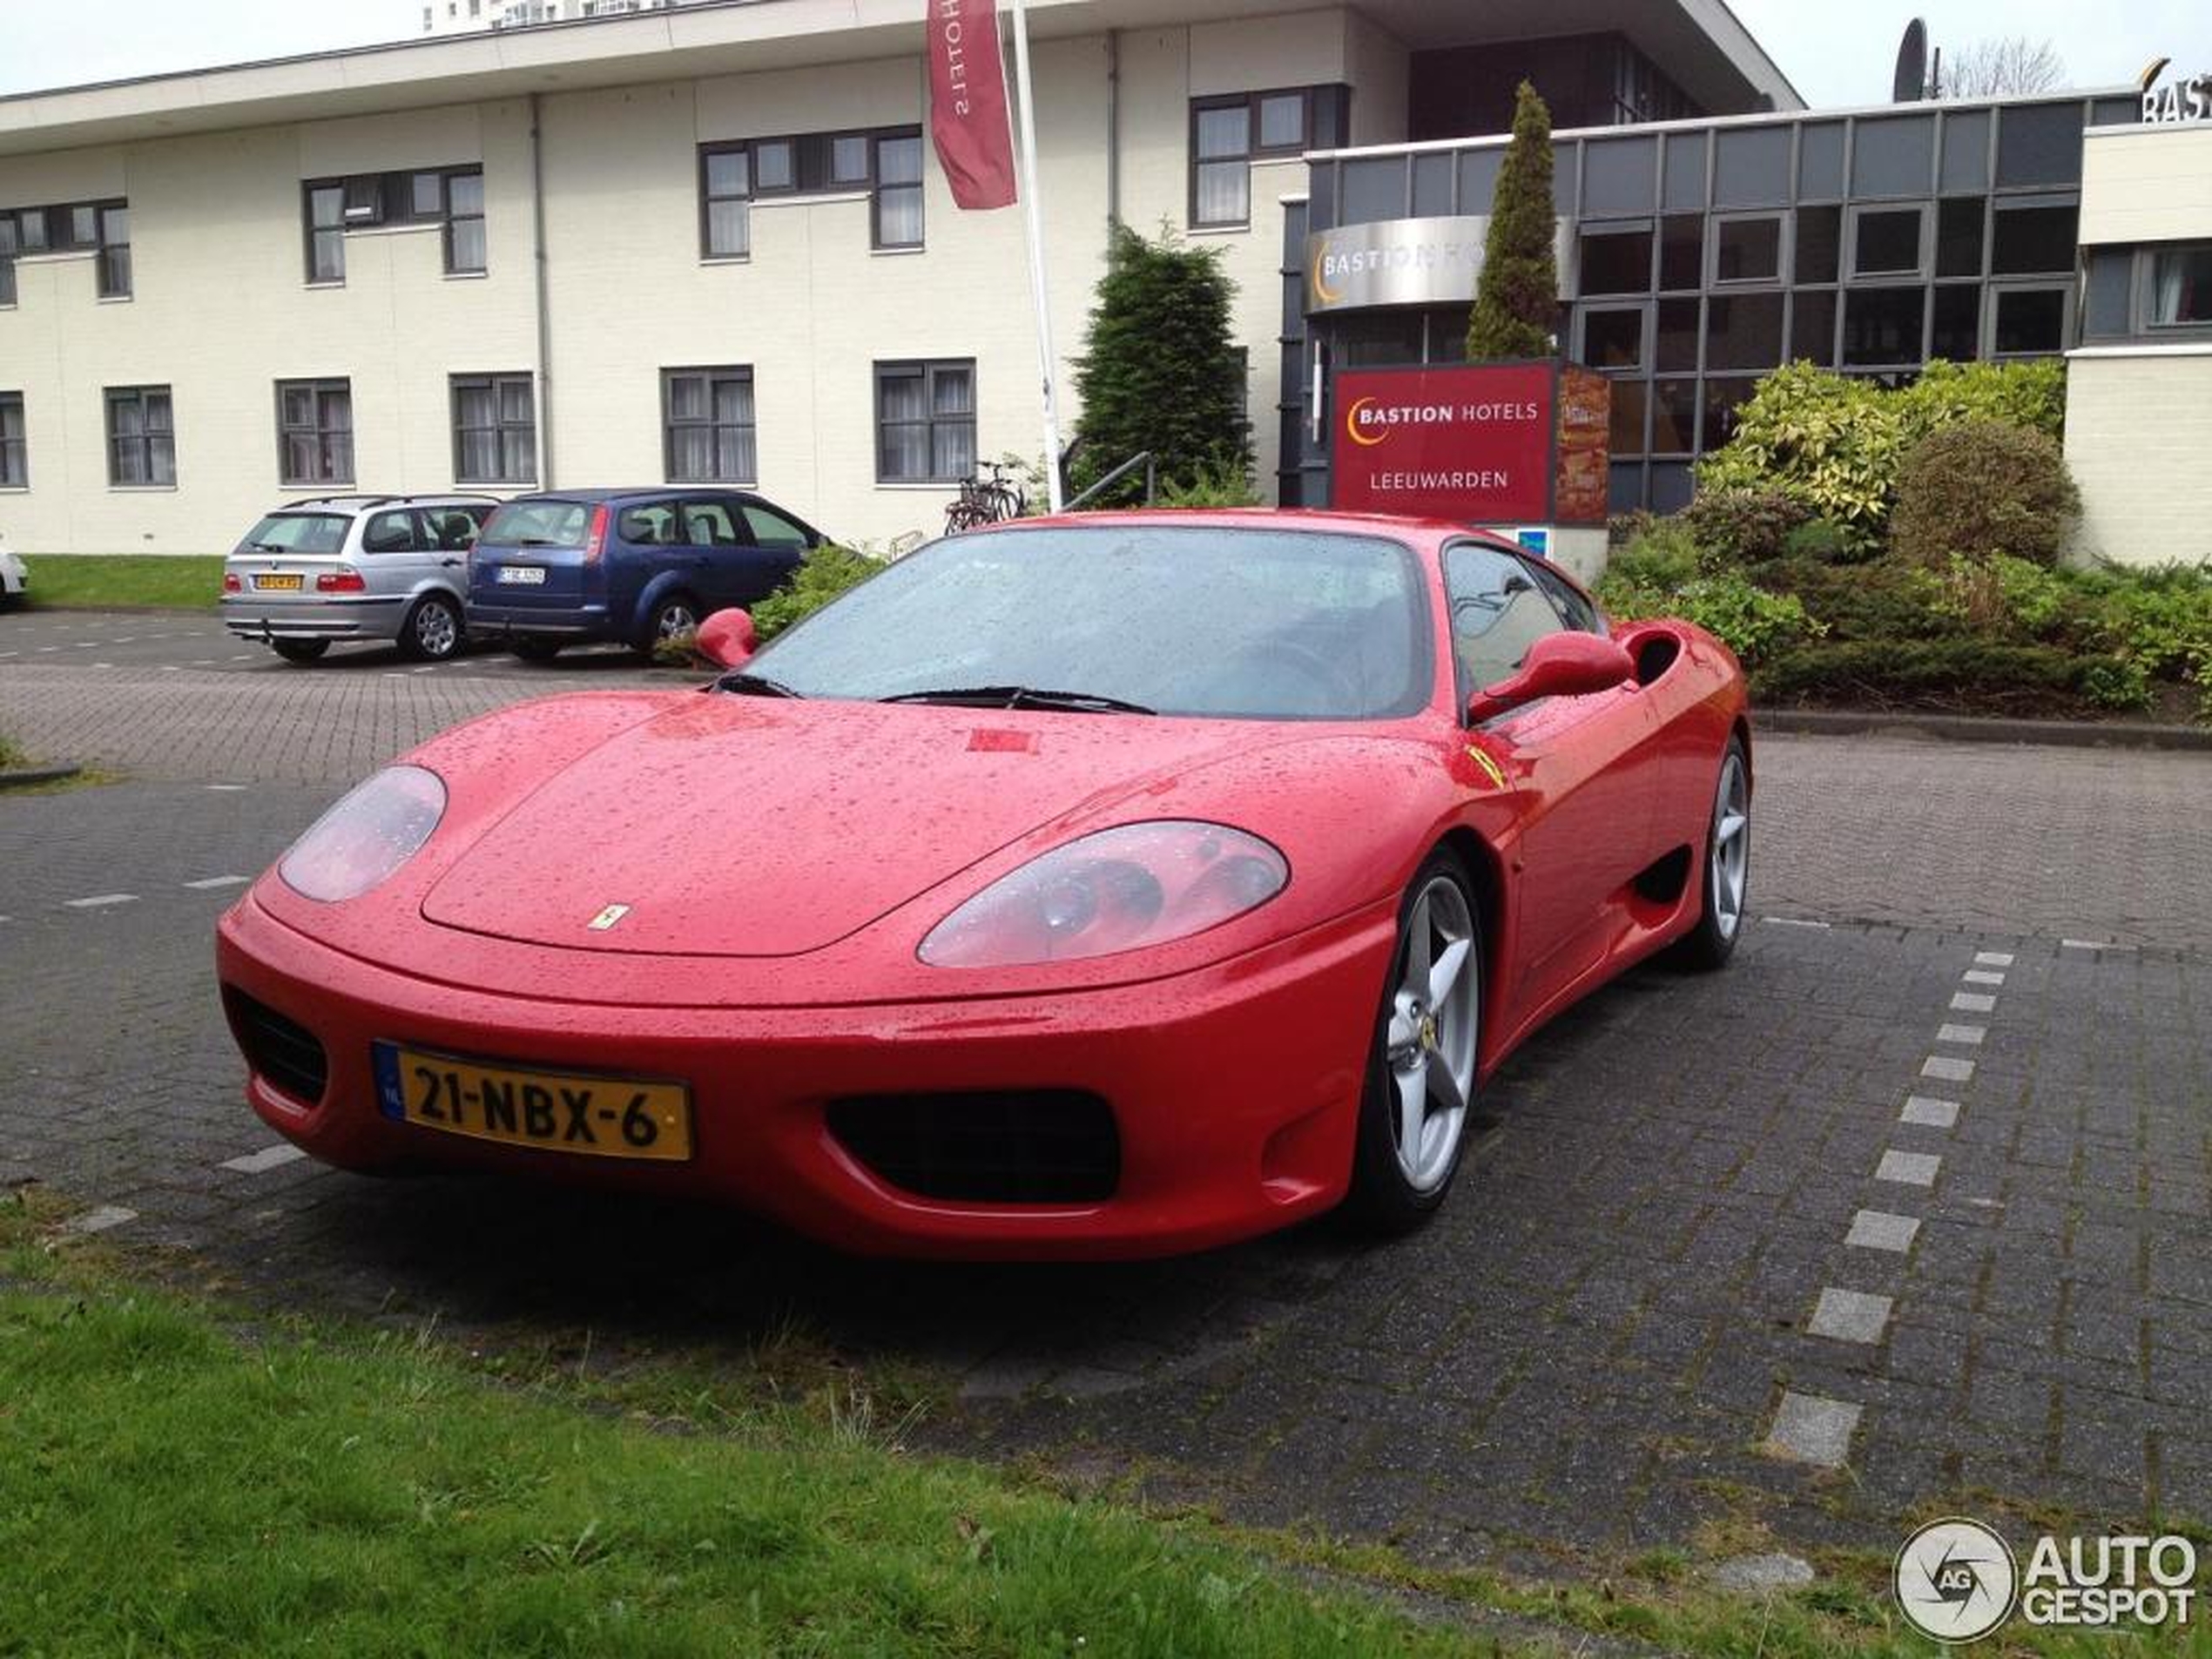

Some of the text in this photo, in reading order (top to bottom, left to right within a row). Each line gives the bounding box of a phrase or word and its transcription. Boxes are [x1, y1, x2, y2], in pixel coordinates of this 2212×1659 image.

[1325, 243, 1437, 276] BASTION
[1359, 403, 1538, 424] BASTION HOTELS
[1371, 472, 1508, 489] LEEUWARDEN
[415, 1067, 658, 1148] 21-NBX-6
